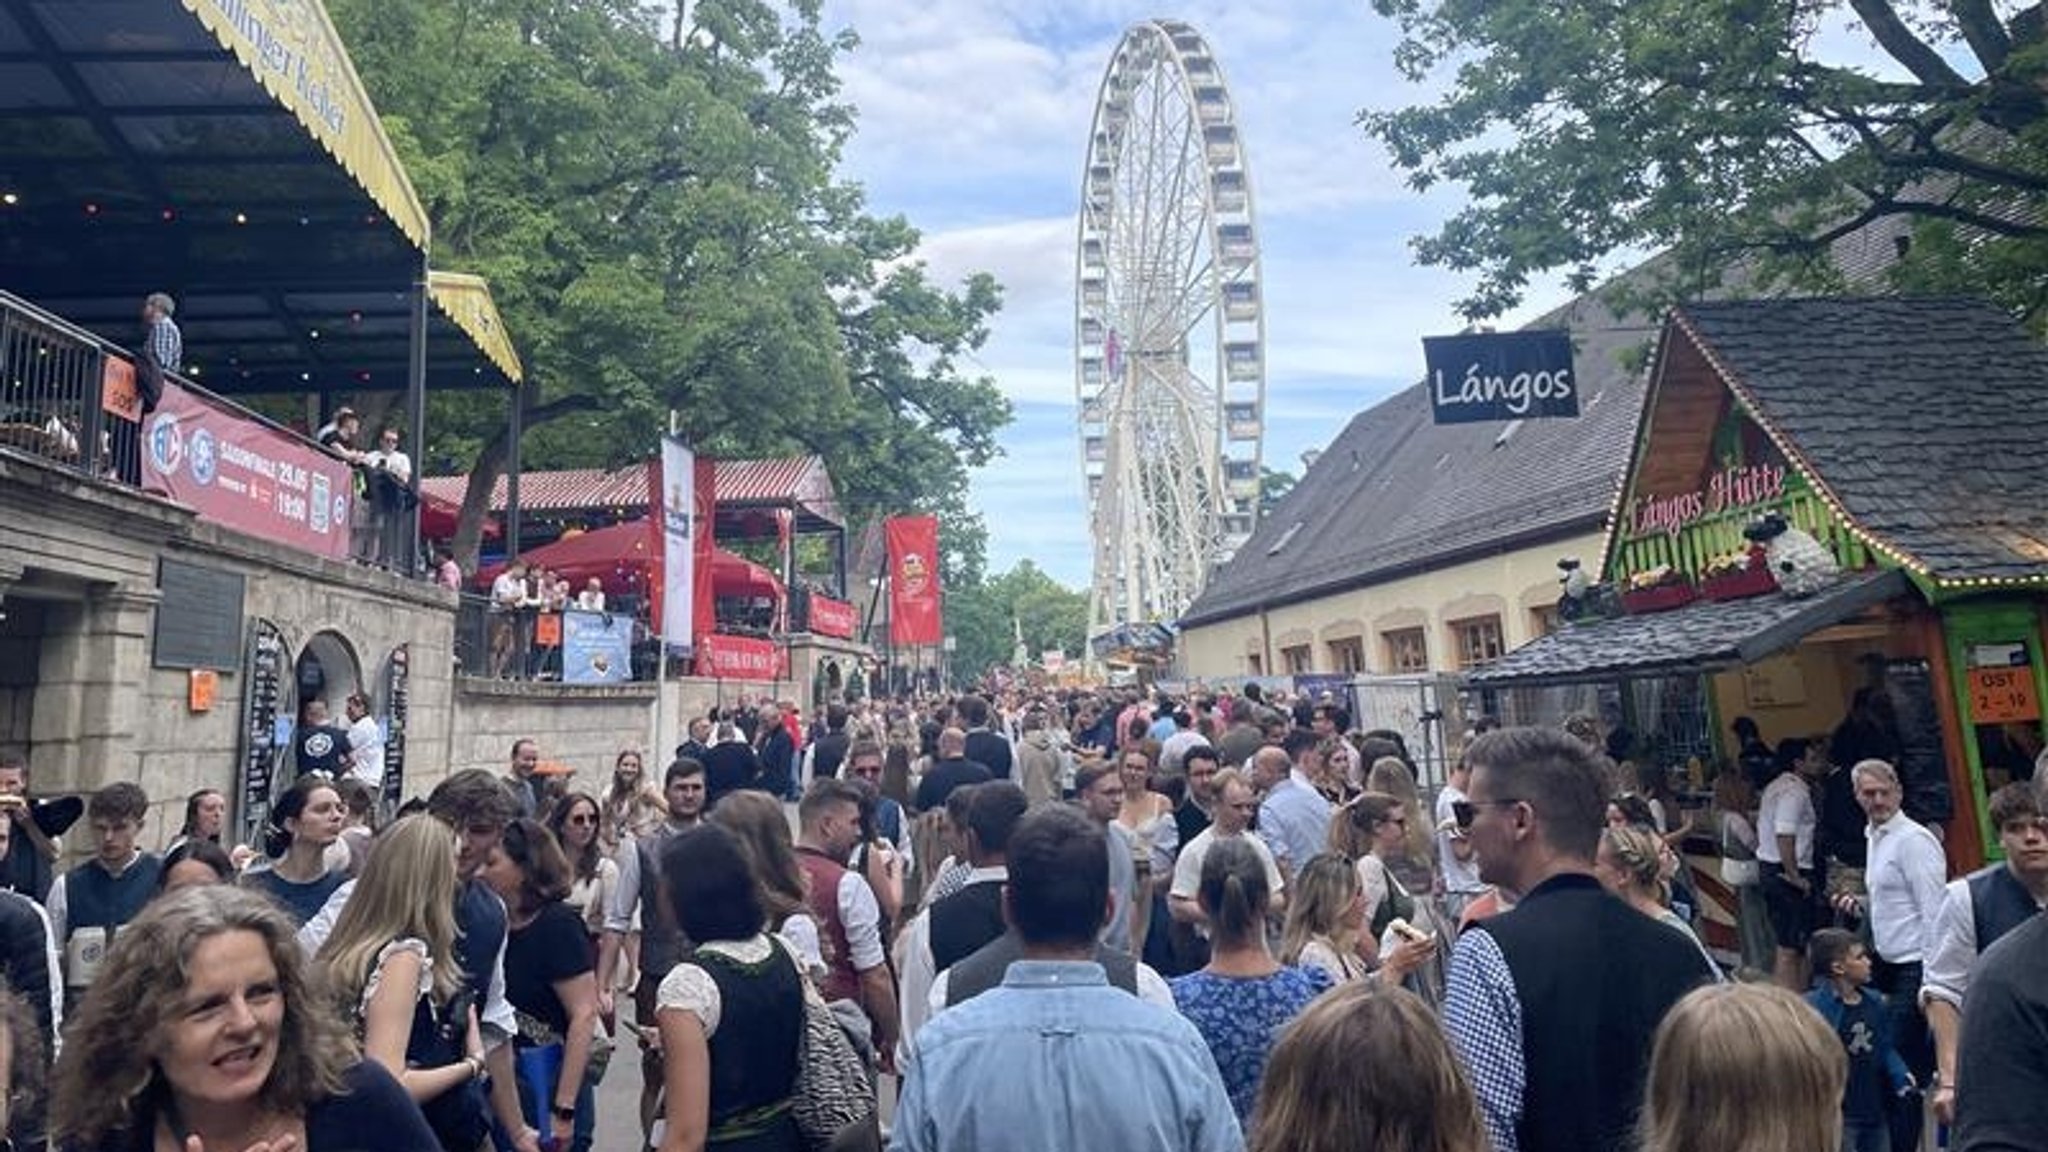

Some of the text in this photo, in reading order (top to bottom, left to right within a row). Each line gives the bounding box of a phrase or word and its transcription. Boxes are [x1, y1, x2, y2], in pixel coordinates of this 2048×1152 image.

[1436, 363, 1571, 413] Lángos
[1630, 463, 1786, 537] Lángos Hütte
[1981, 672, 2015, 688] OST
[1979, 695, 1990, 711] 2
